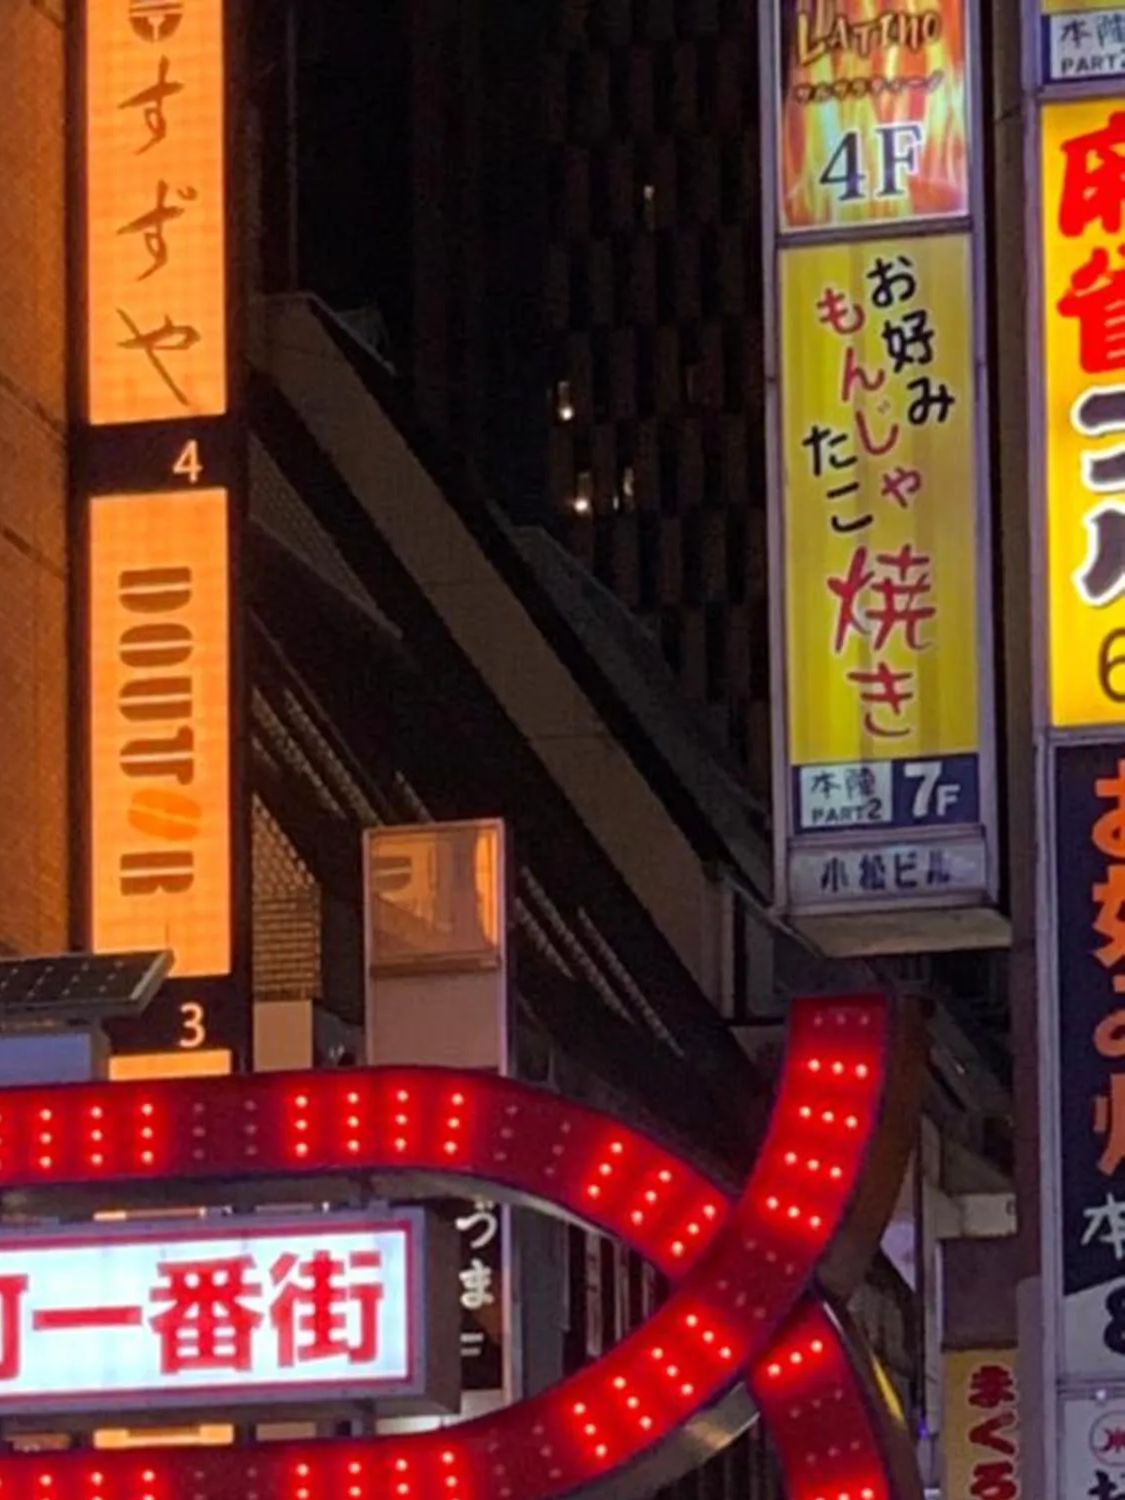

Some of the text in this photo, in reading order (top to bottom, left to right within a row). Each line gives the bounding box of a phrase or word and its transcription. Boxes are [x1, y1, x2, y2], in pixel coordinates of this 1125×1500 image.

[819, 123, 922, 201] 4F
[117, 55, 201, 406] すずや
[865, 256, 956, 426] お好み
[817, 288, 922, 510] もんじゃ
[173, 440, 203, 482] 4
[802, 425, 874, 533] たこ
[827, 544, 937, 738] 焼き
[118, 566, 204, 896] DOUTOR
[810, 797, 883, 824] PART2
[903, 762, 960, 818] 7F
[820, 851, 952, 893] 小松ビル
[179, 1004, 205, 1048] 3
